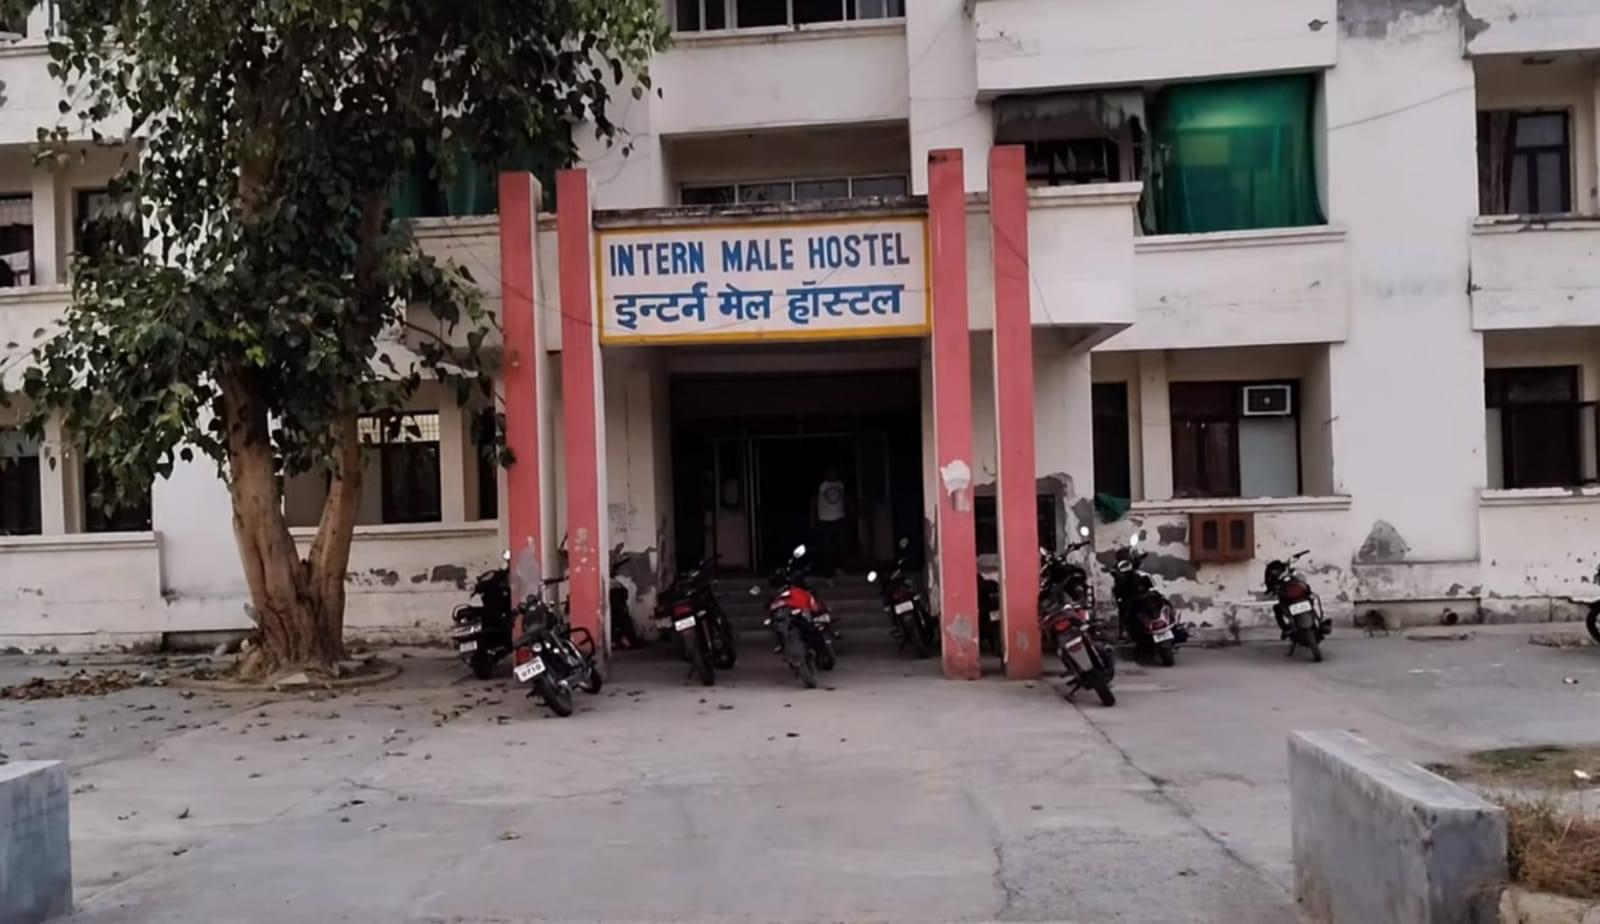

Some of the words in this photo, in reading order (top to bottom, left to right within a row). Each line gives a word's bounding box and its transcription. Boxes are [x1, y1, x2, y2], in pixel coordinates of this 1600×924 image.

[609, 241, 705, 276] INTERN
[722, 239, 794, 273] MALE
[808, 232, 910, 269] HOSTEL
[614, 282, 708, 329] इन्टर्न
[718, 283, 773, 320] मेल
[787, 280, 905, 324] हॉस्टल
